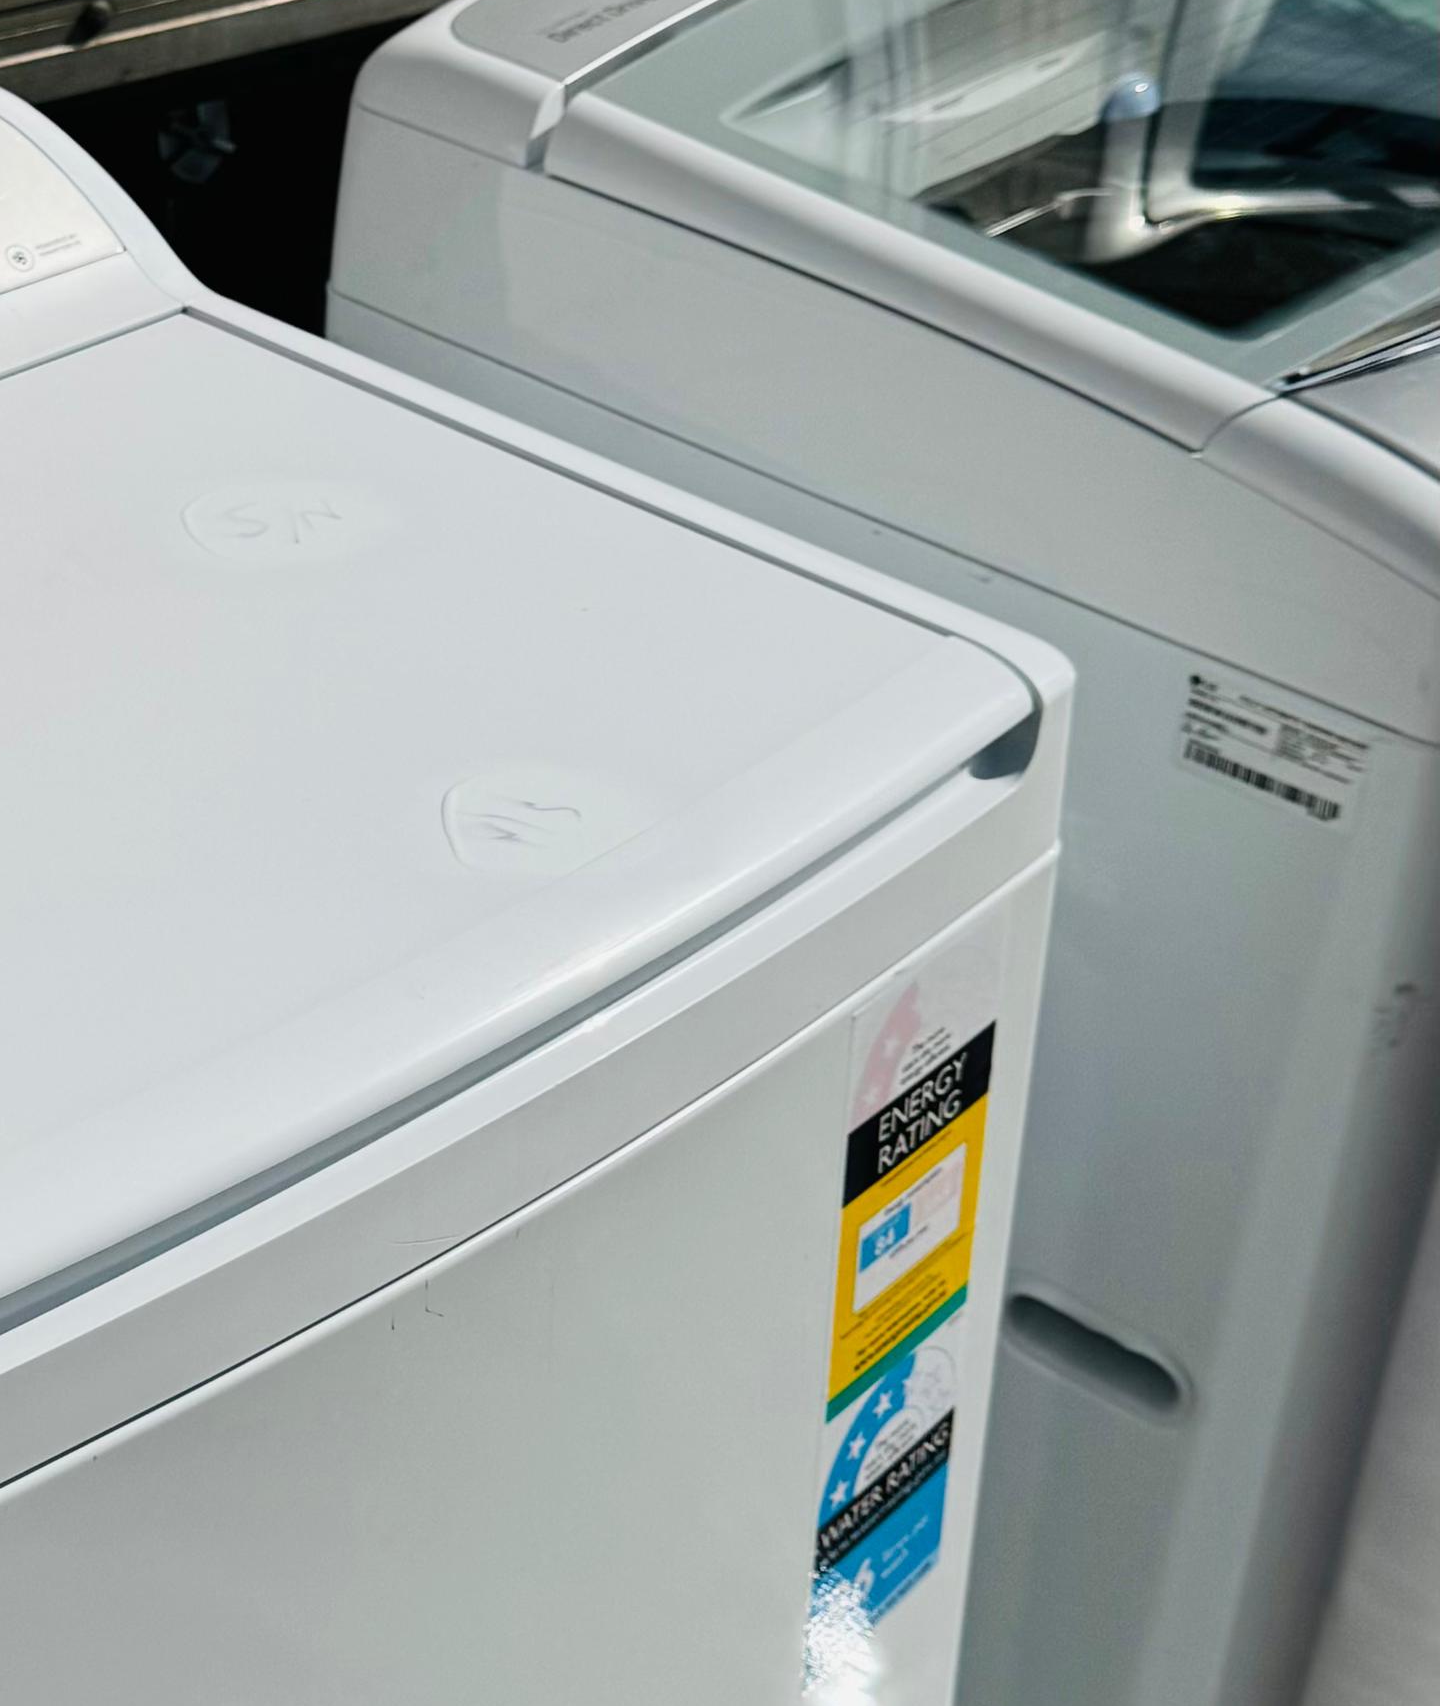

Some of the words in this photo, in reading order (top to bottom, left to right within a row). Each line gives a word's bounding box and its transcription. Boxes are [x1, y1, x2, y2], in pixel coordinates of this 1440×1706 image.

[877, 1089, 962, 1174] RATING
[878, 1052, 968, 1142] ENERGY
[820, 1485, 884, 1548] WATER
[886, 1421, 950, 1493] RATING
